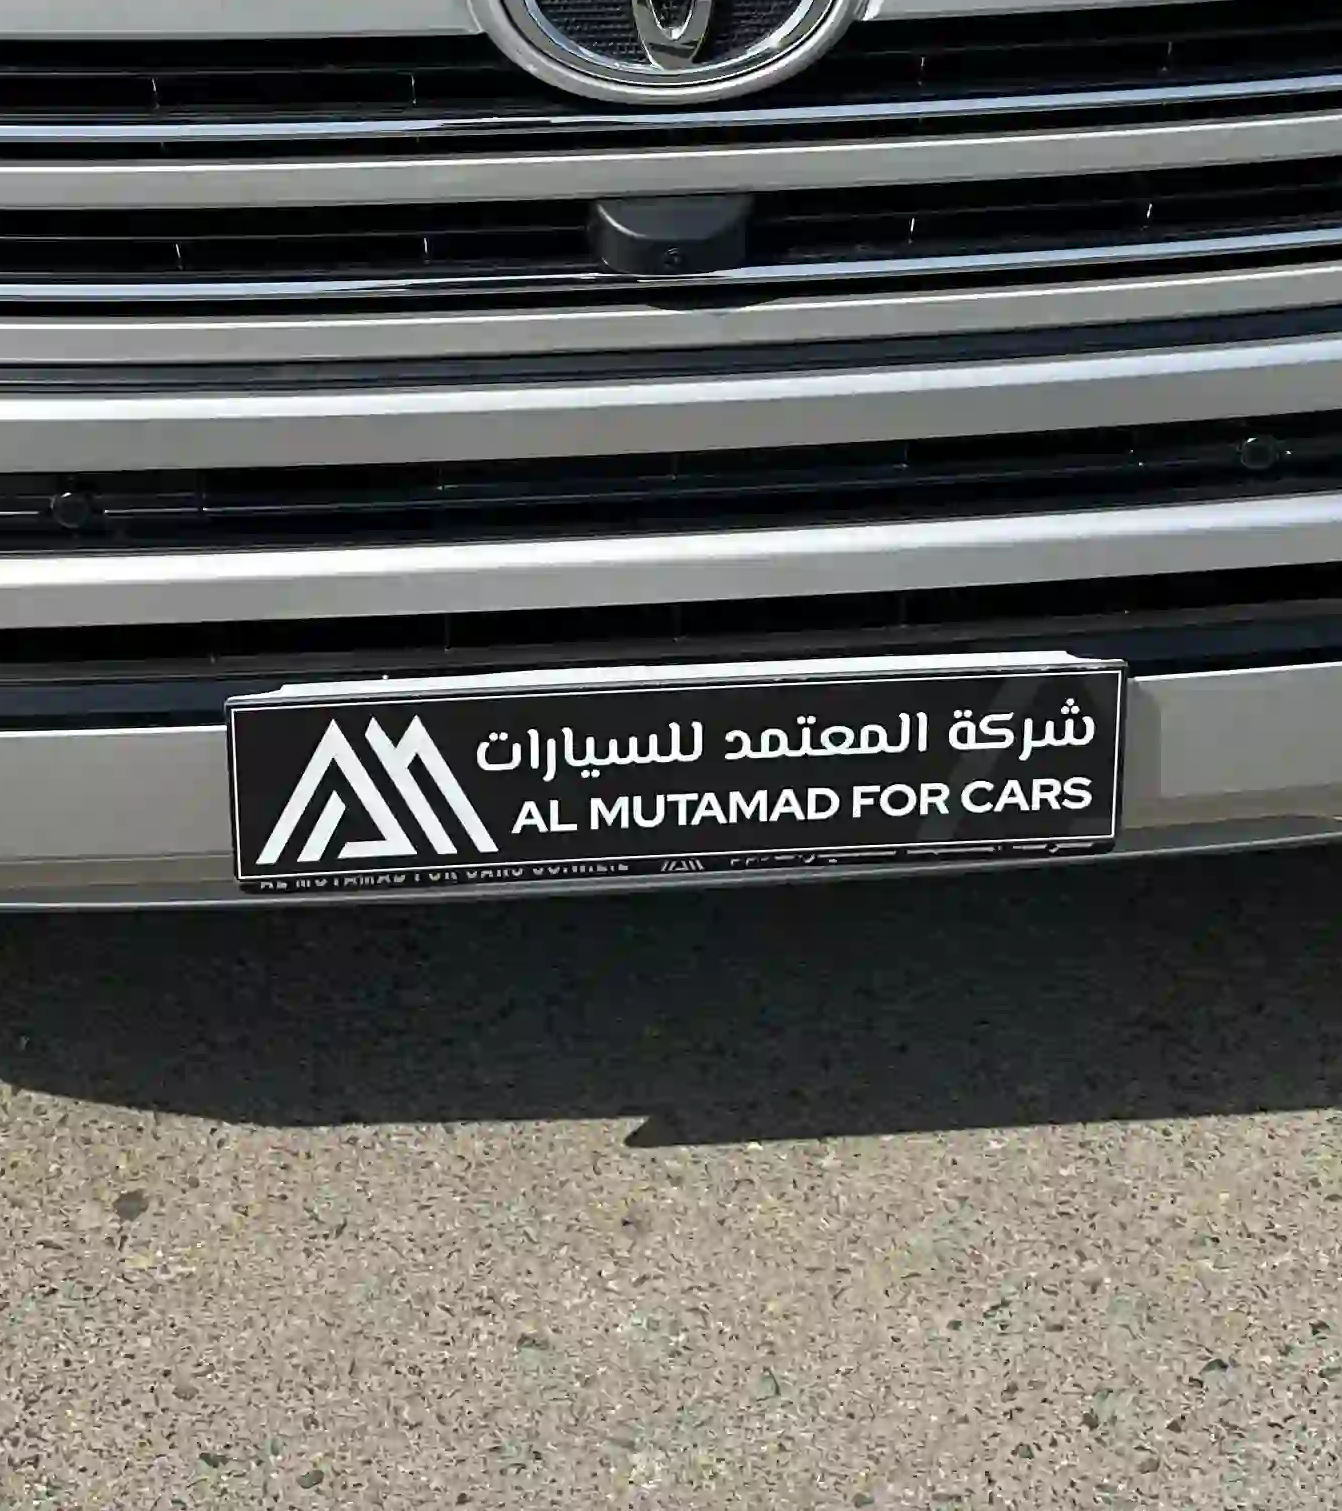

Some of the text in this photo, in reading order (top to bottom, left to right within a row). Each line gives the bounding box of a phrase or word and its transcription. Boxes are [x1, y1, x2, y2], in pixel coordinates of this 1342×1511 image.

[477, 698, 1095, 782] شركة المعتمد للسيارات
[511, 776, 1093, 834] AL MUTAMAD FOR CARS
